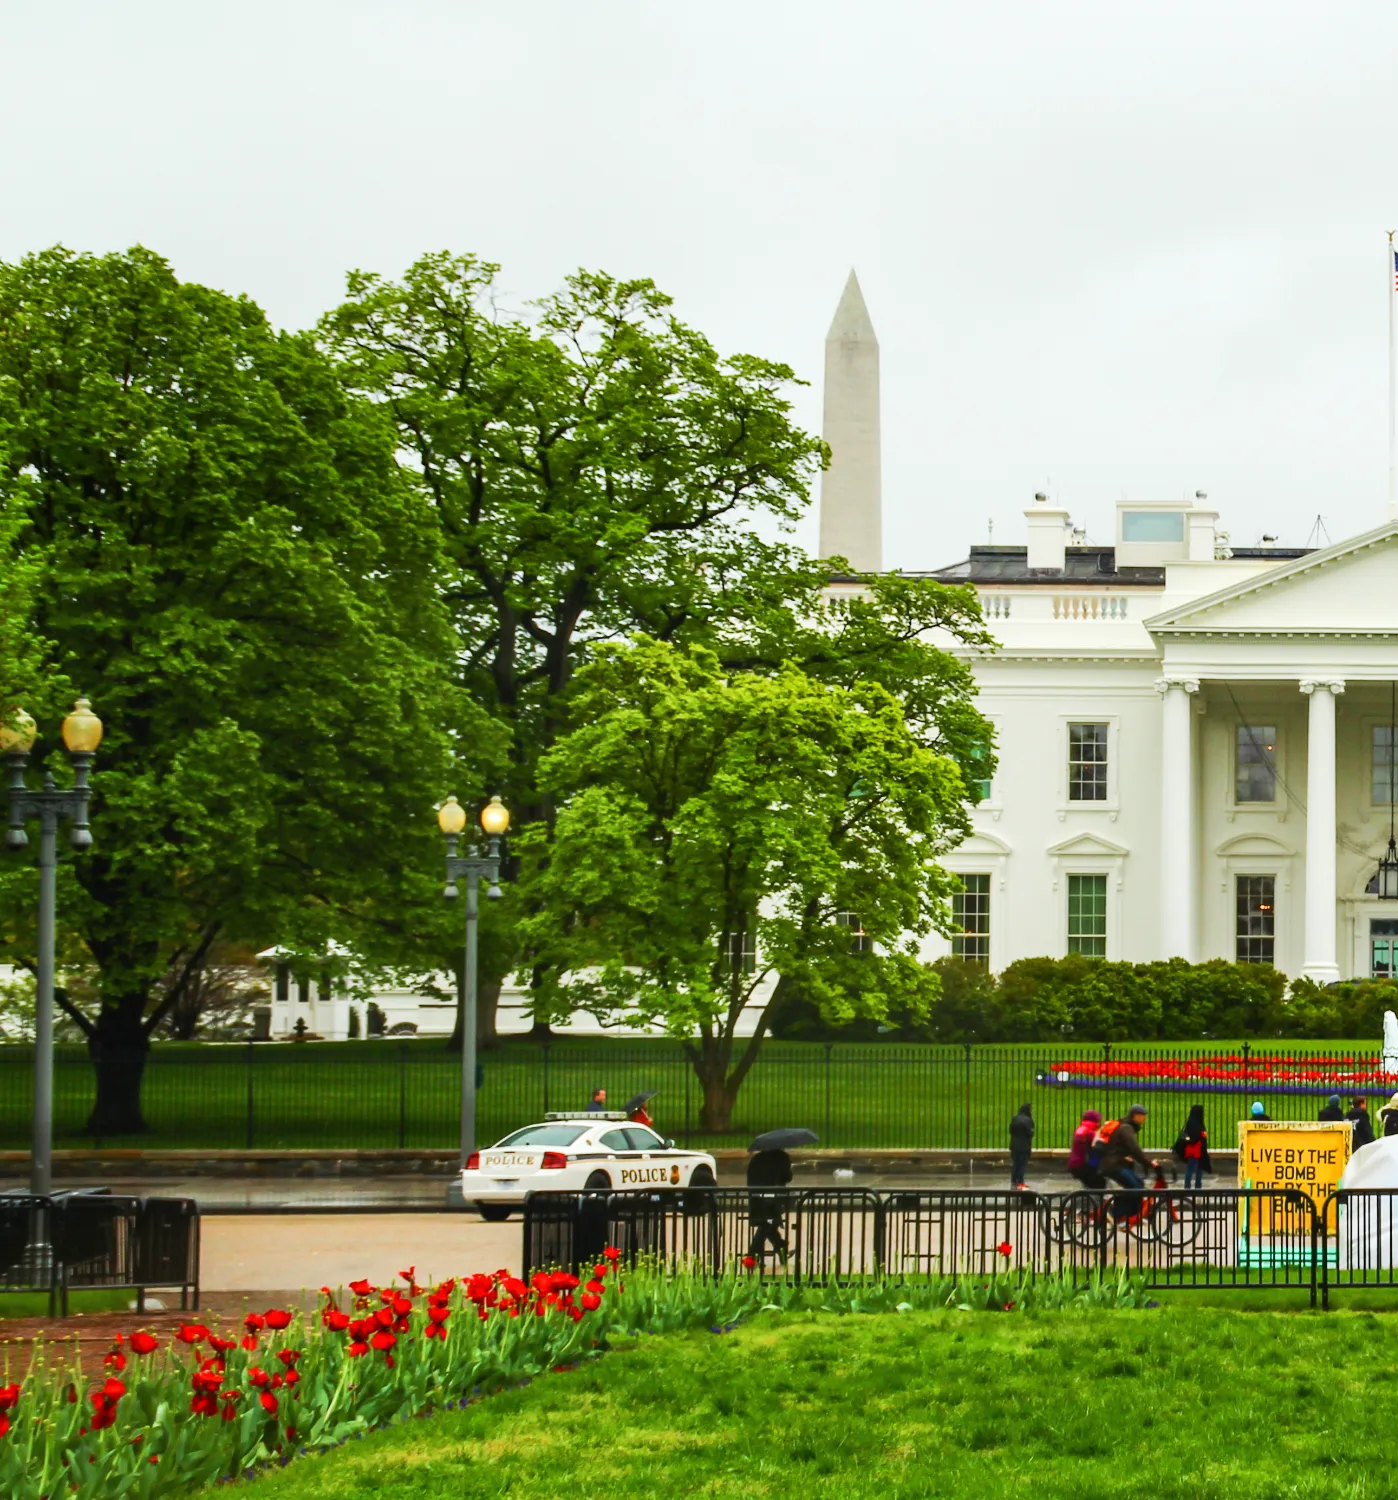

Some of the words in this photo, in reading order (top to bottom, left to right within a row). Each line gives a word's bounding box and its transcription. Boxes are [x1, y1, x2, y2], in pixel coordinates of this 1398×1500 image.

[485, 1155, 535, 1166] POLICE
[1251, 1148, 1282, 1163] LIVE
[1285, 1149, 1305, 1164] BY
[1307, 1149, 1337, 1165] THE
[621, 1168, 668, 1184] POLICE
[1274, 1165, 1316, 1180] BOMB
